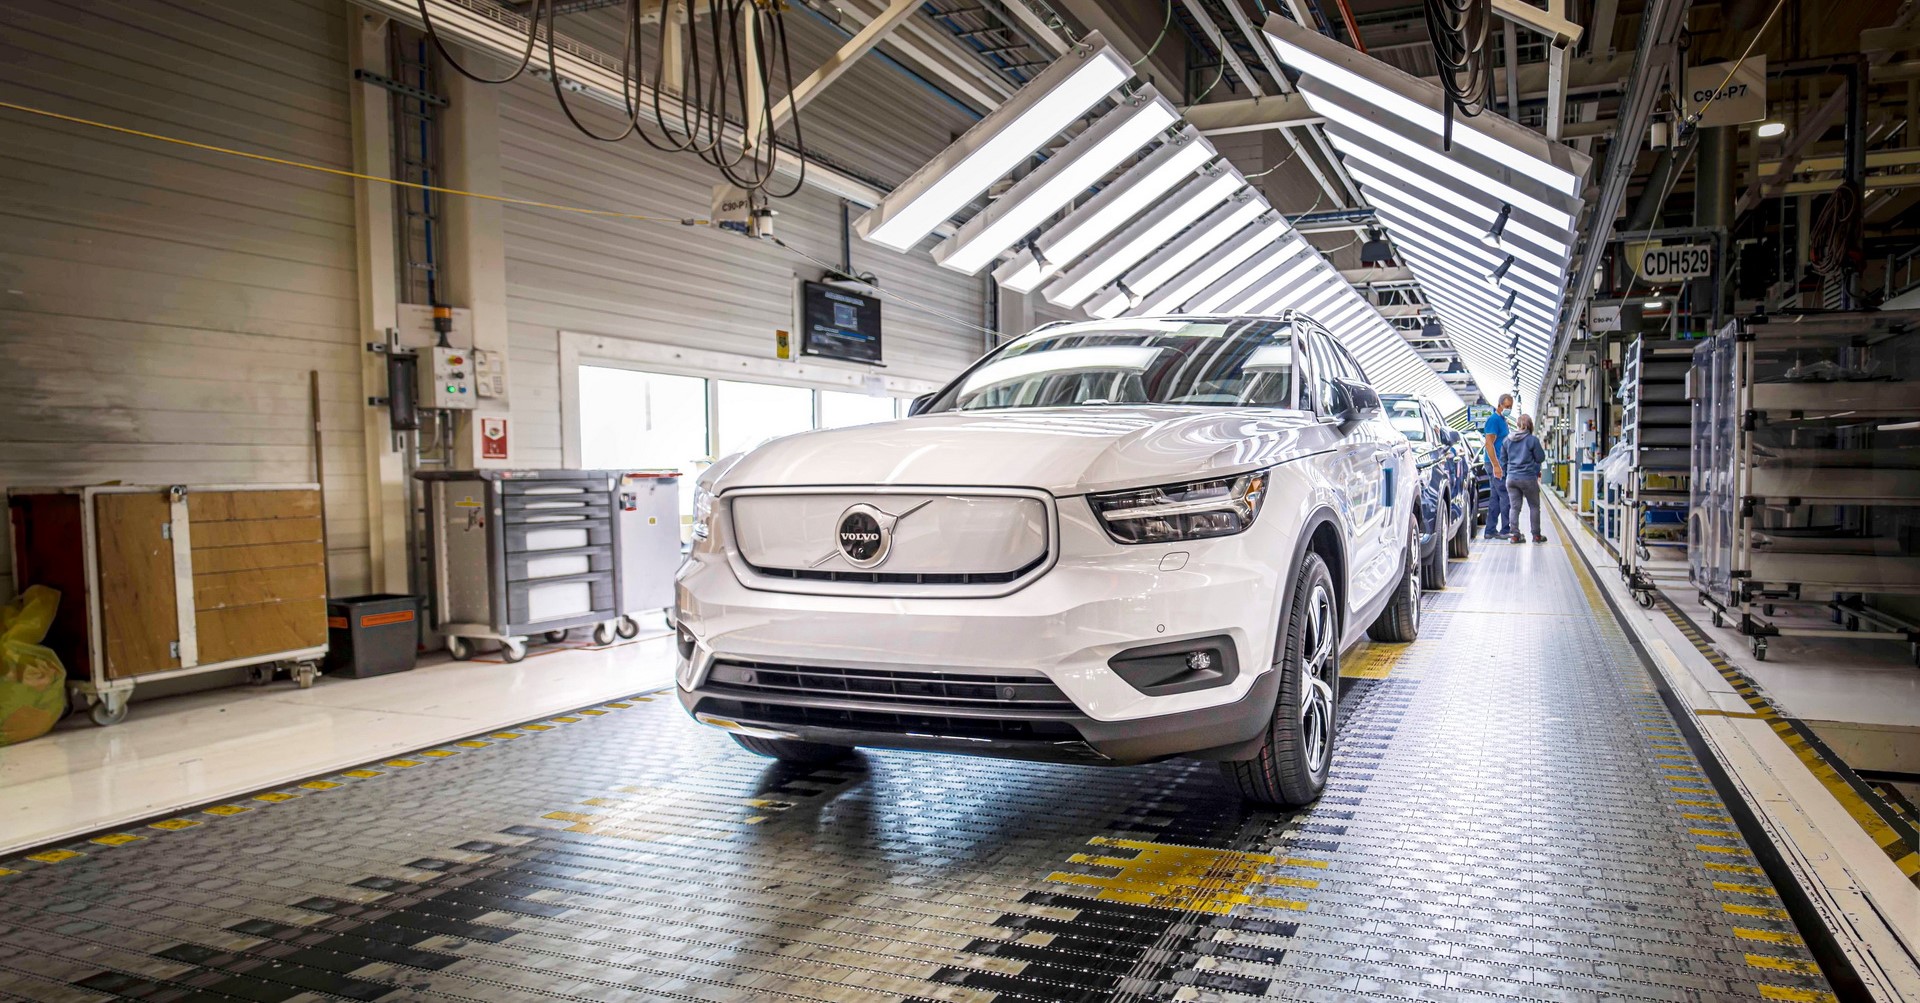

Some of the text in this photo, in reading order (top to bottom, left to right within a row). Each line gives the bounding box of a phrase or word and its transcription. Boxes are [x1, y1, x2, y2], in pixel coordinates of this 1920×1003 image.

[1693, 84, 1747, 102] C90-P7
[1645, 249, 1709, 276] CDH529
[840, 532, 880, 541] VOLVO
